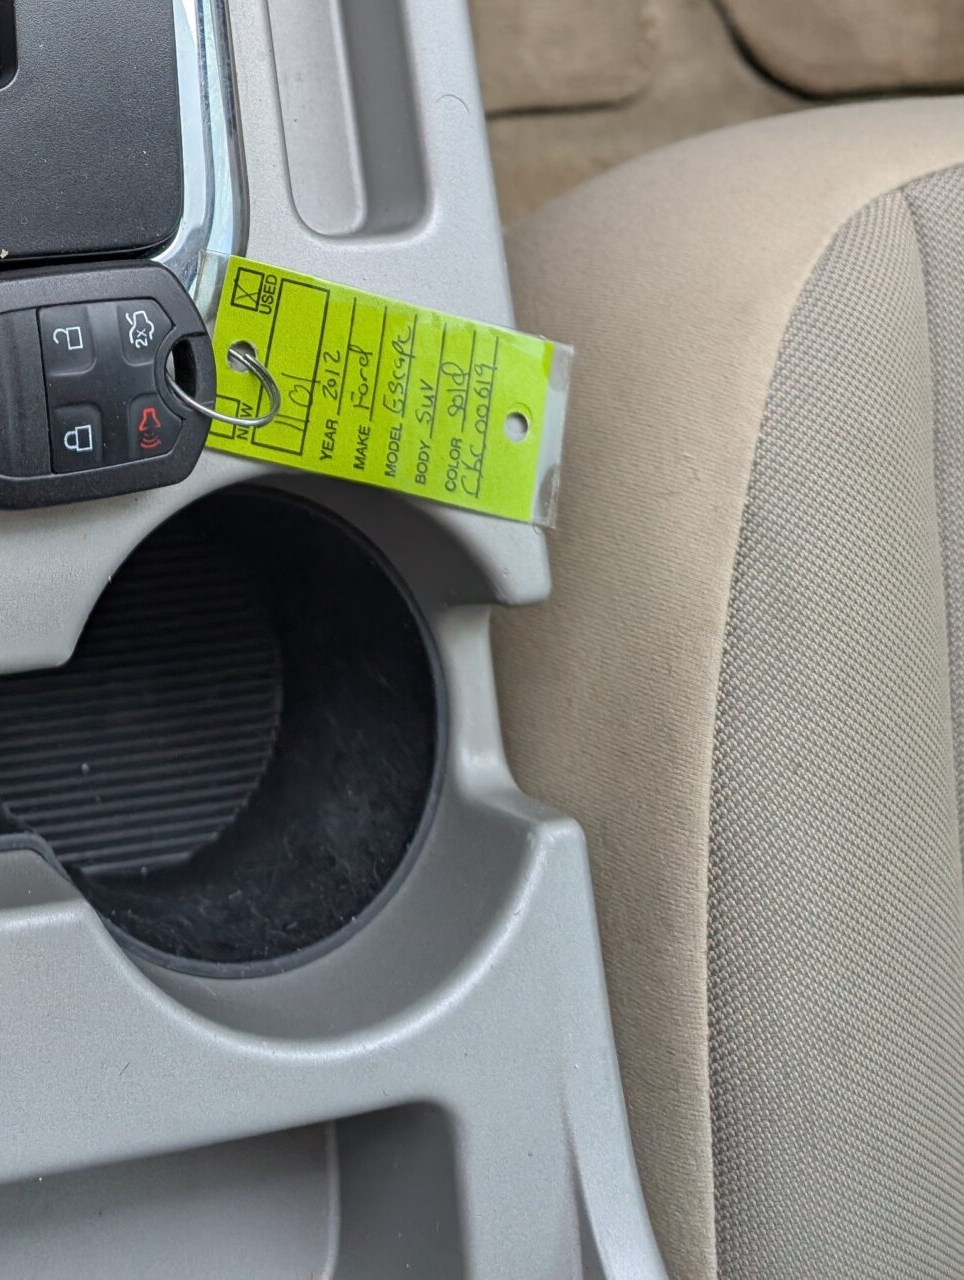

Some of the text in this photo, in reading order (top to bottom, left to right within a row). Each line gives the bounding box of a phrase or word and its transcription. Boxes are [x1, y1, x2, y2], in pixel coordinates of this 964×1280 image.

[258, 274, 278, 315] USED
[236, 402, 253, 440] NW
[319, 349, 341, 461] YEAR 2012
[349, 344, 373, 471] MAKE Ford
[384, 422, 403, 478] MODEL
[414, 439, 431, 485] BODY
[444, 437, 463, 493] COLOR
